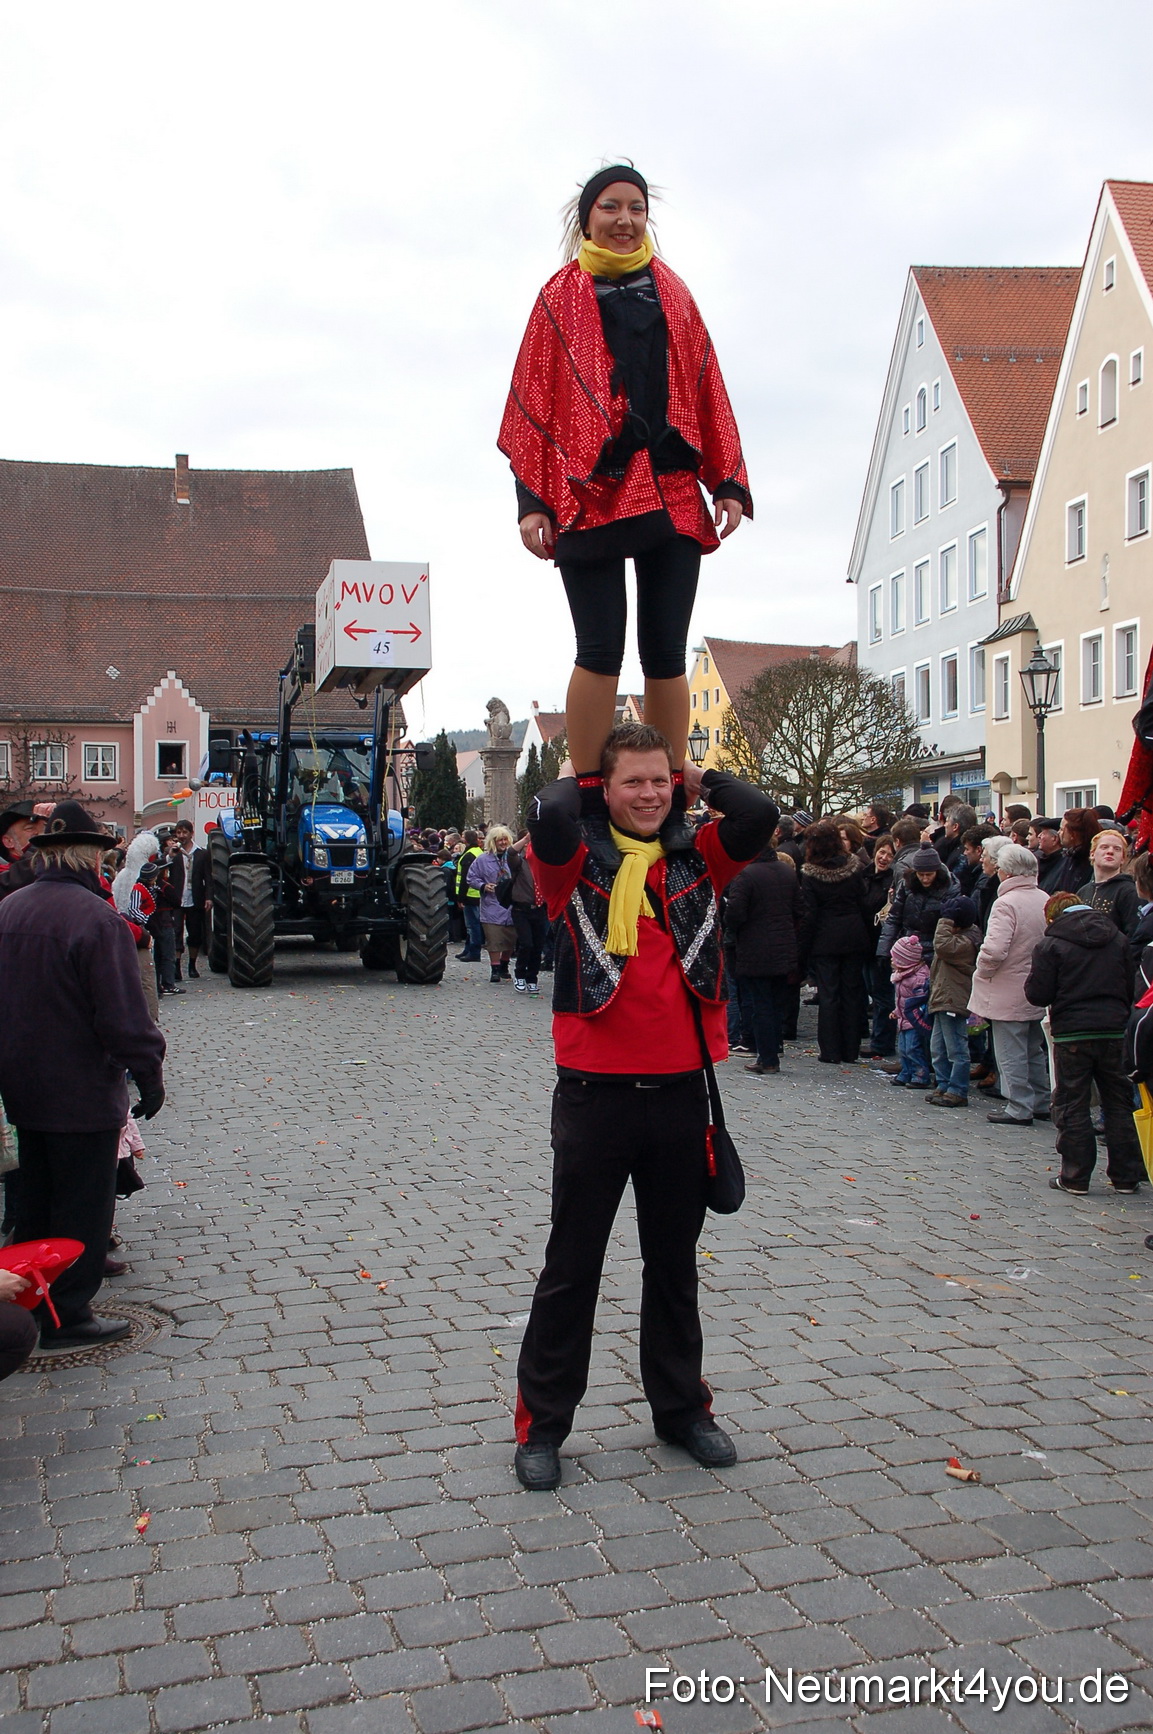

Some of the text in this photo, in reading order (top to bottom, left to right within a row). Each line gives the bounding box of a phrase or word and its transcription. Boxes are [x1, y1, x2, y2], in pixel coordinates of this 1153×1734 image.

[373, 641, 391, 655] 45
[955, 770, 987, 786] SCHLECKE
[198, 791, 238, 808] HOCH
